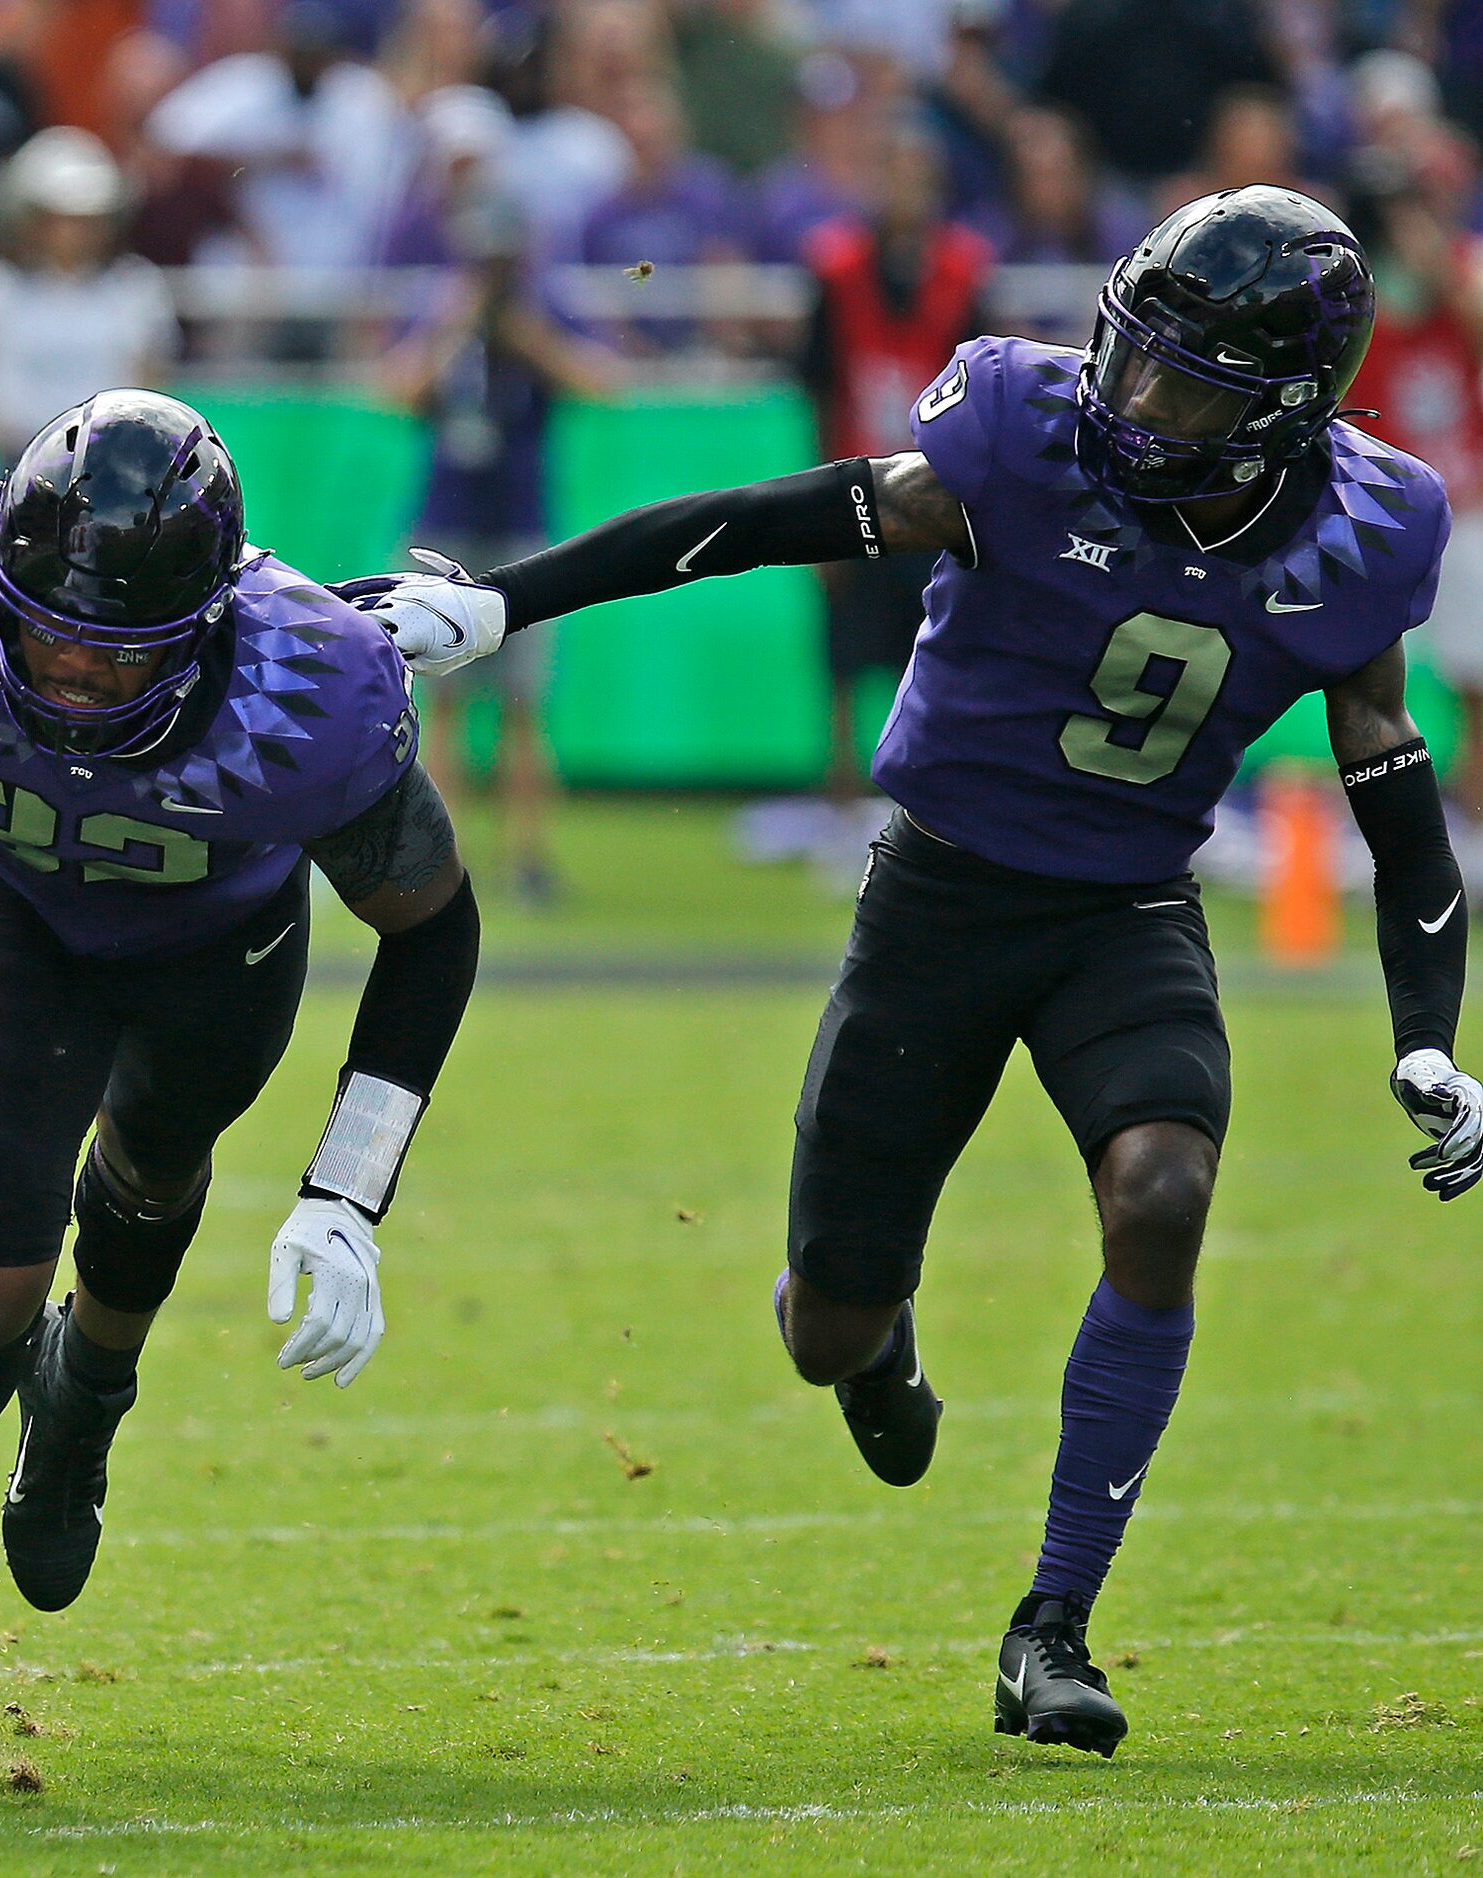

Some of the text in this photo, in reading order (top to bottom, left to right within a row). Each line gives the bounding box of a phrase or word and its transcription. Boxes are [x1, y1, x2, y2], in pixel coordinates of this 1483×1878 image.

[850, 484, 876, 540] PRO
[1058, 532, 1120, 574] XII
[1183, 566, 1208, 580] TCU
[116, 649, 135, 663] IN
[1058, 611, 1232, 786] 9
[70, 766, 95, 781] TCU
[1344, 760, 1388, 787] PRO
